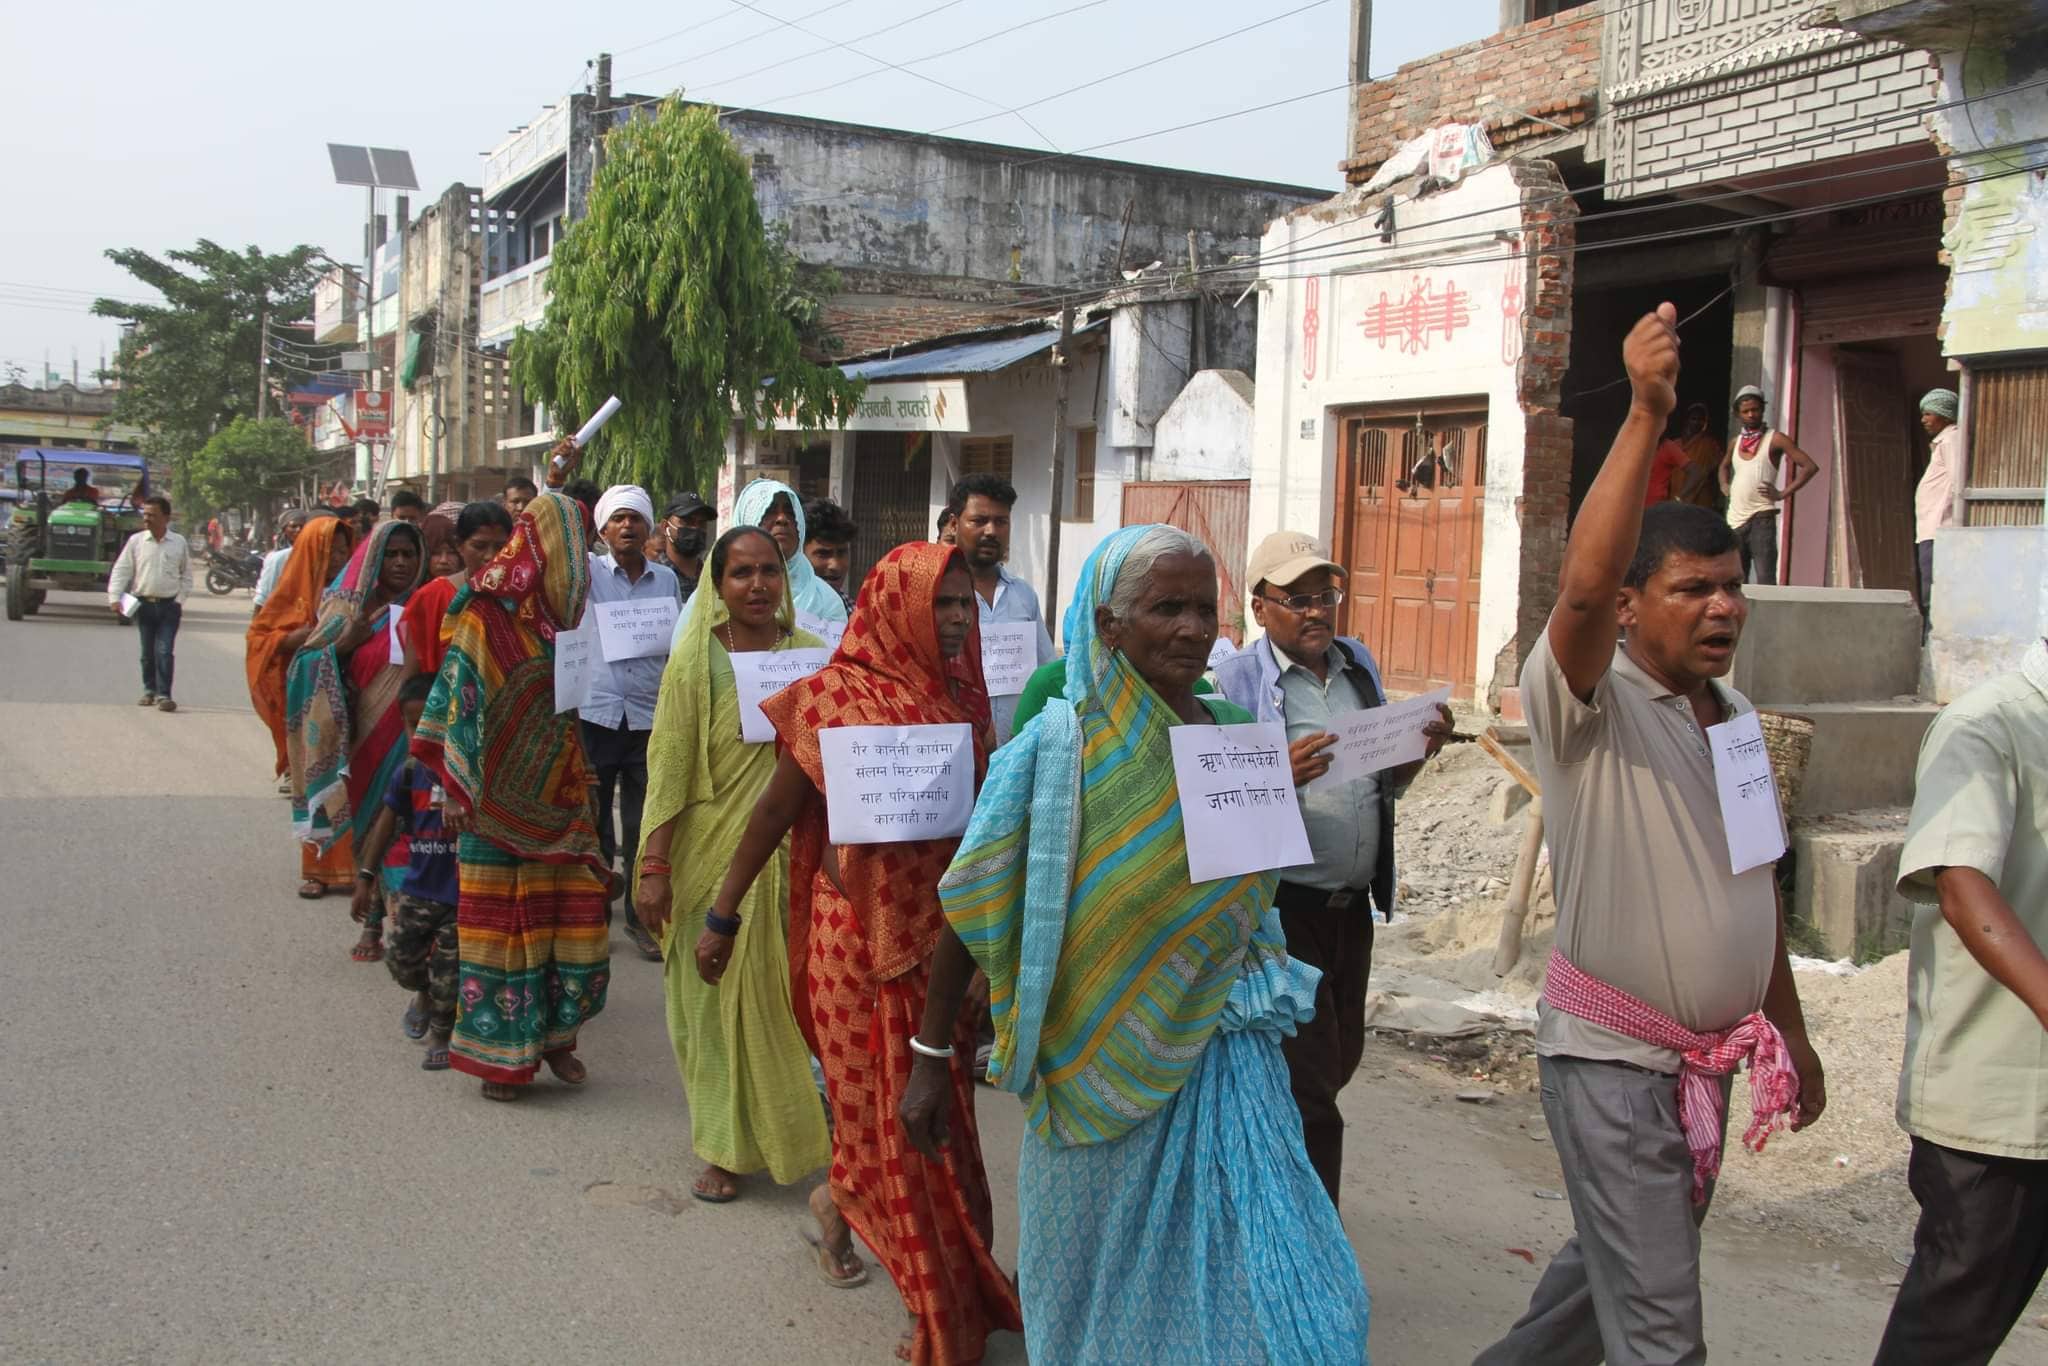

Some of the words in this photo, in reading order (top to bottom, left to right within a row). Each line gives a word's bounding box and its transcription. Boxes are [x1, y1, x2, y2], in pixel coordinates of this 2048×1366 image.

[852, 741, 867, 757] गैर
[1197, 752, 1226, 773] ऋण
[856, 765, 887, 778] संलग्न
[860, 792, 883, 804] साह
[1272, 787, 1288, 805] गर
[926, 812, 939, 824] गर
